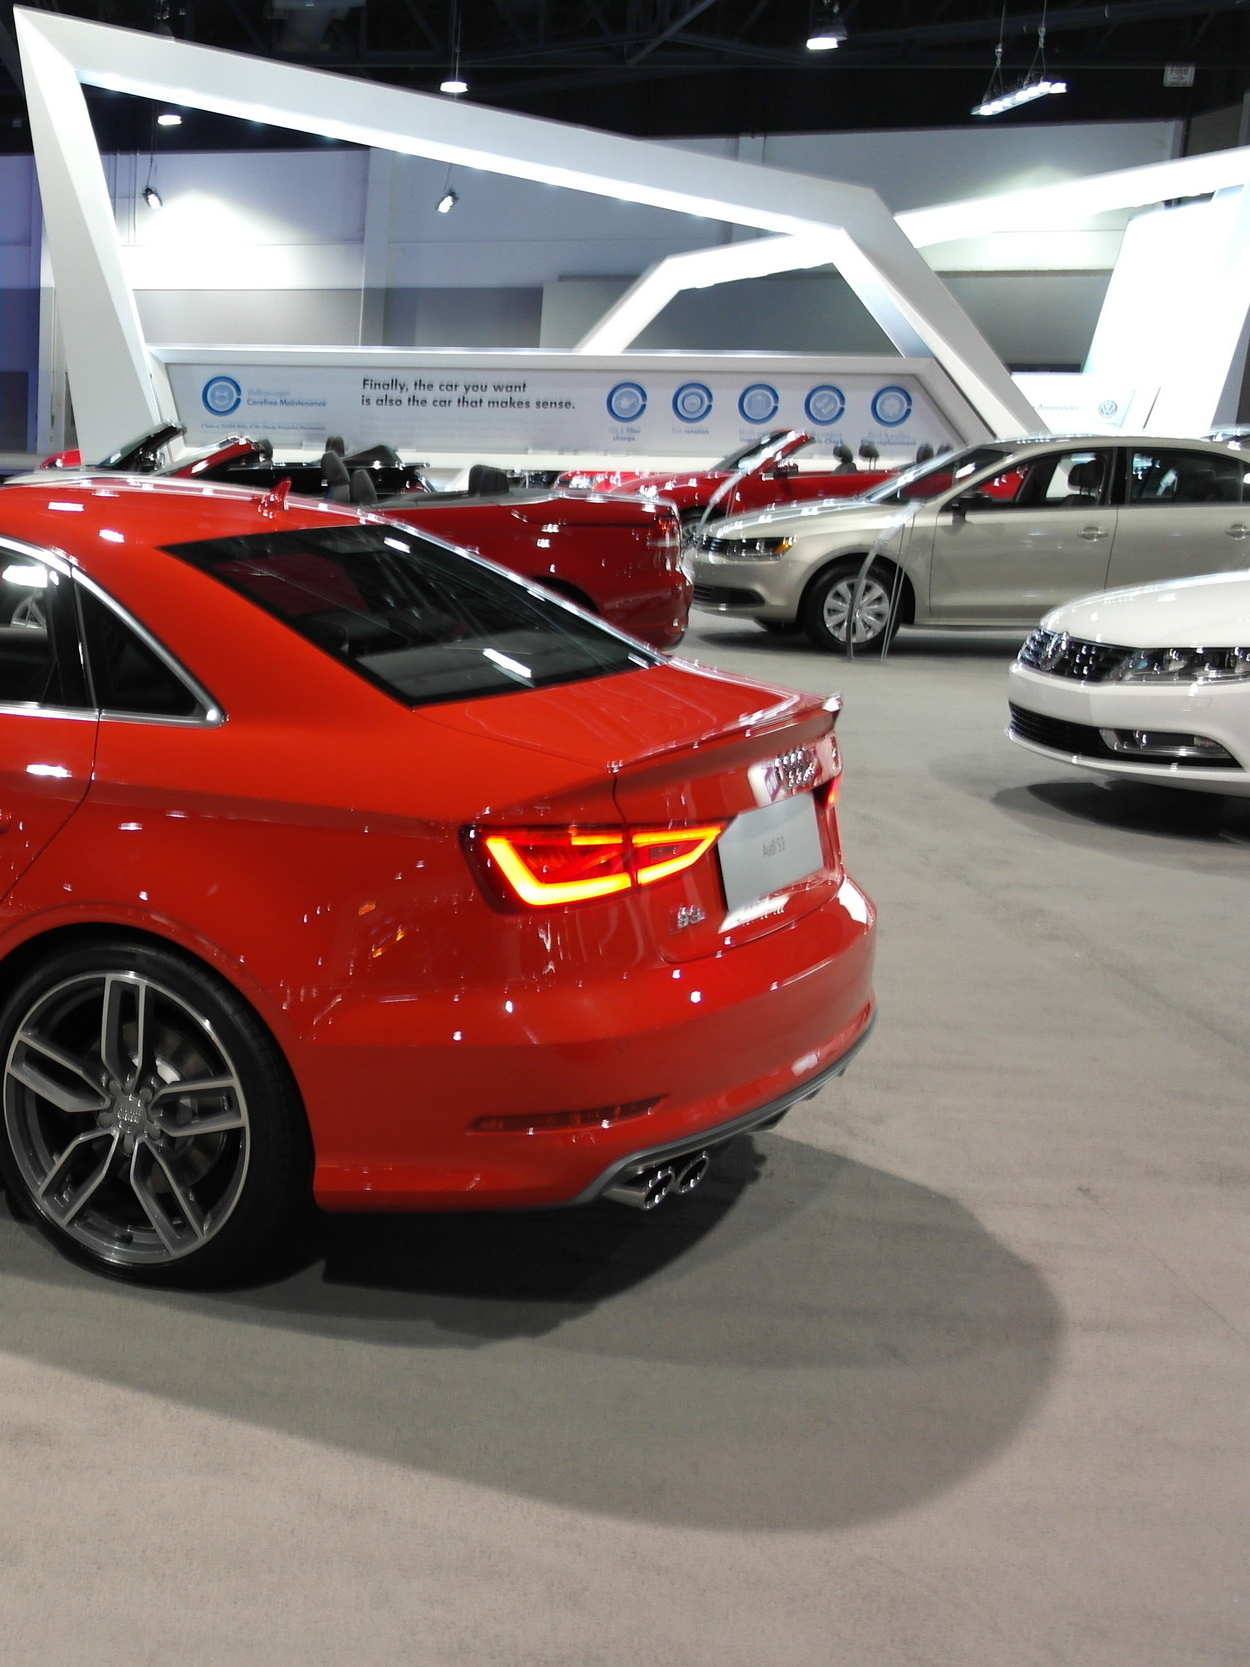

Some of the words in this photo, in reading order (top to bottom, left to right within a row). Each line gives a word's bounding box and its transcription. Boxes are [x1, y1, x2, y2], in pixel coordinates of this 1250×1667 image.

[362, 378, 409, 392] Finally,
[414, 379, 433, 391] the
[439, 383, 459, 392] car
[464, 384, 488, 394] you
[493, 382, 527, 393] want
[247, 399, 278, 407] Carefree
[279, 399, 327, 408] Maintenance
[361, 395, 371, 406] is
[375, 395, 402, 407] also
[407, 396, 427, 407] the
[432, 399, 452, 408] car
[457, 397, 483, 408] that
[488, 397, 530, 409] makes
[535, 400, 575, 410] sense.
[762, 839, 776, 858] Audi
